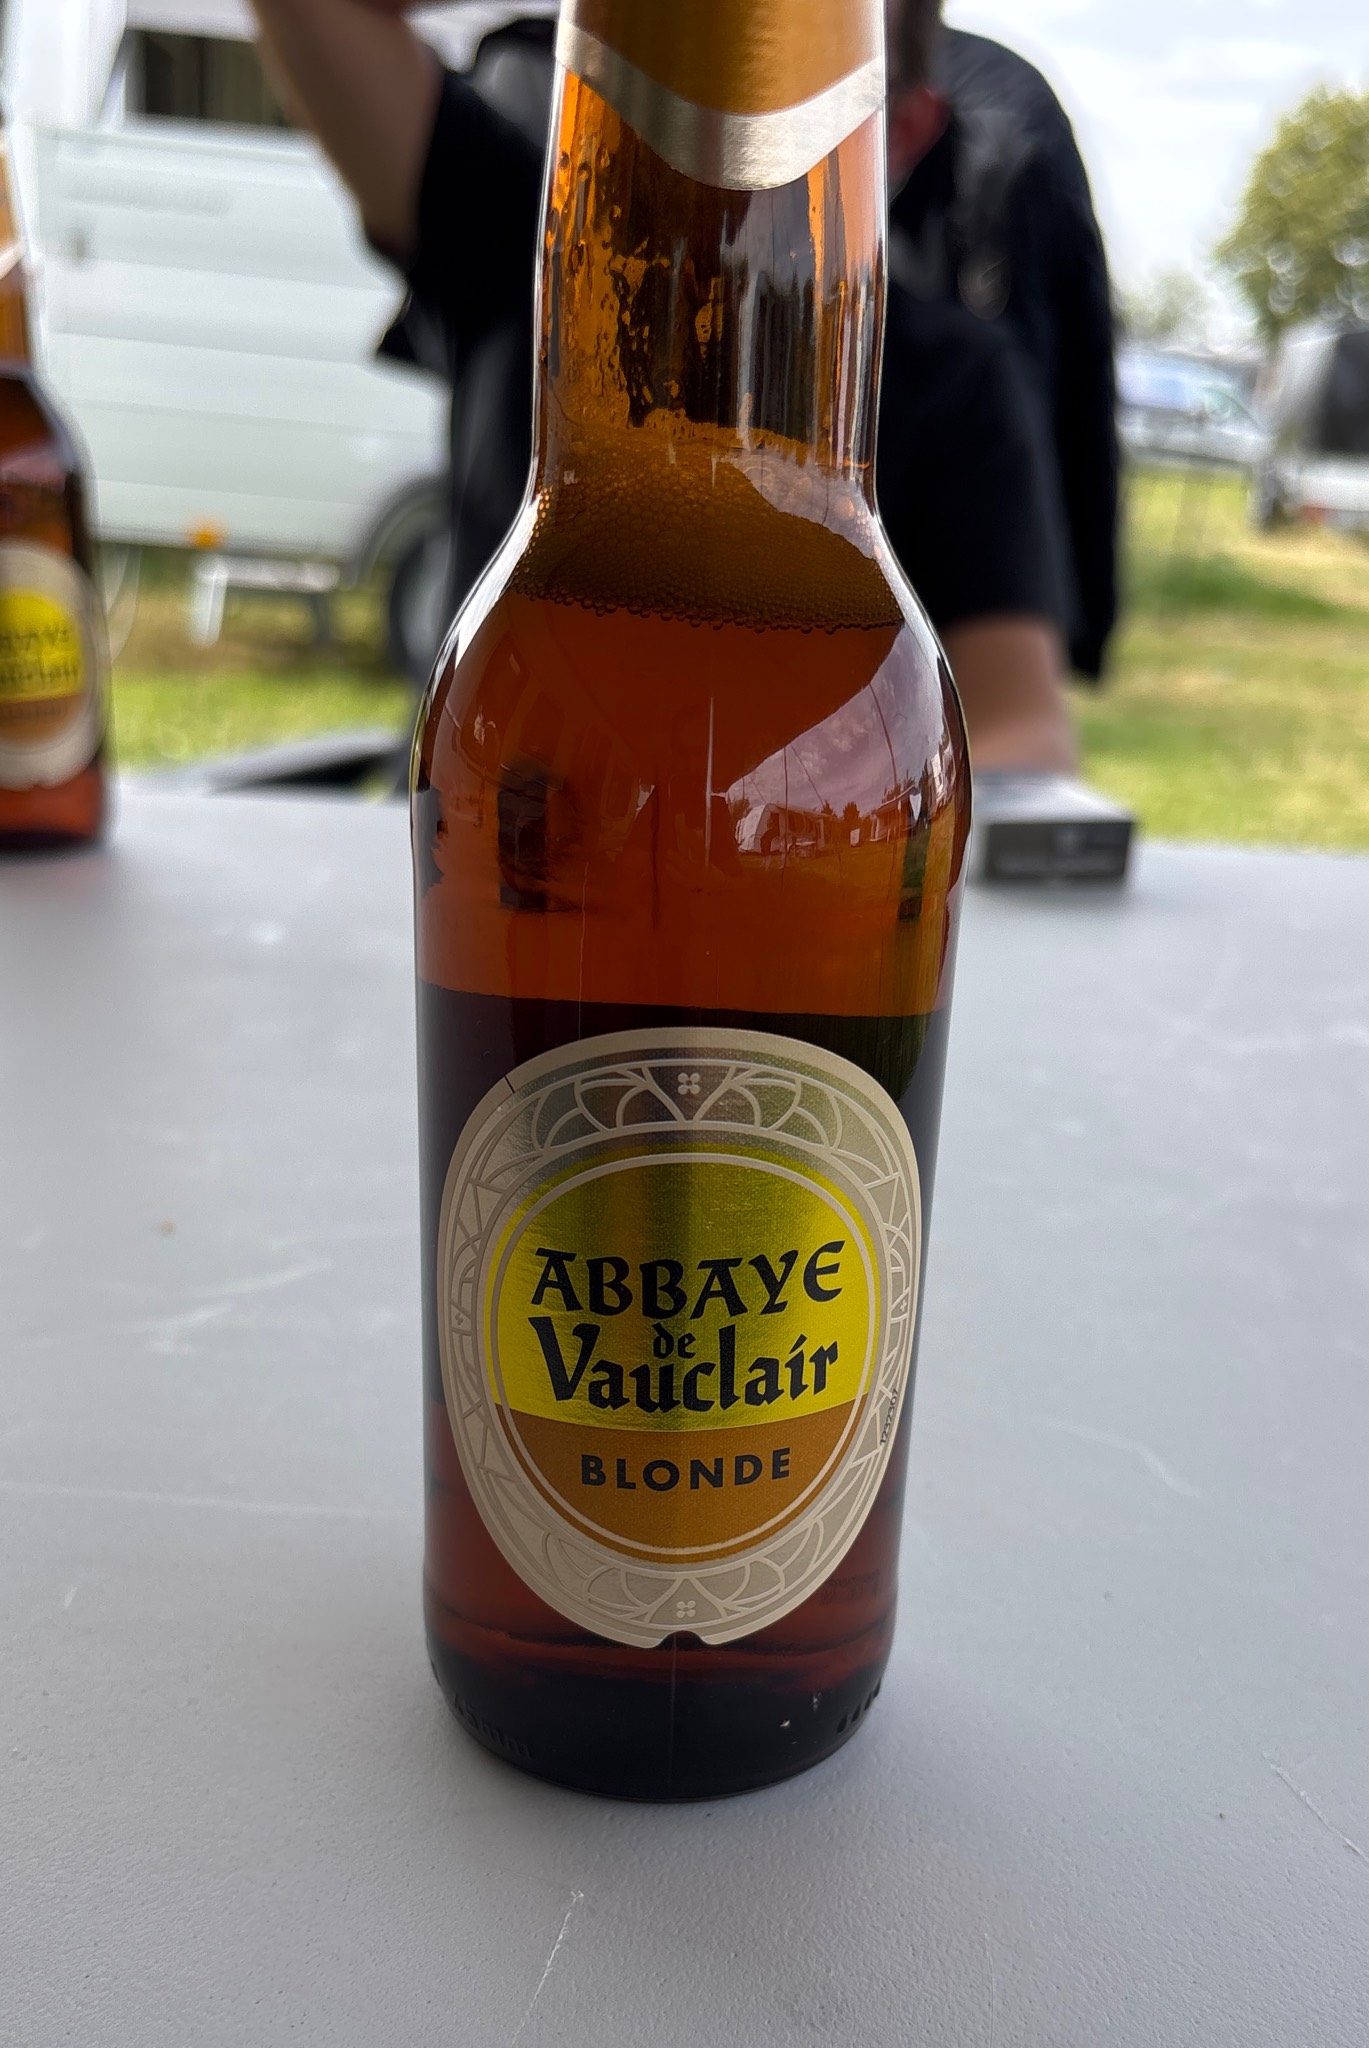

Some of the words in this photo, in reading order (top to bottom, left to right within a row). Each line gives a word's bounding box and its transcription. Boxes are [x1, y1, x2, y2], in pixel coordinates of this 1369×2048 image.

[531, 1240, 845, 1320] ABBAYE
[528, 1316, 838, 1413] Vauclair
[652, 1322, 696, 1359] de
[580, 1447, 791, 1491] BLONDE
